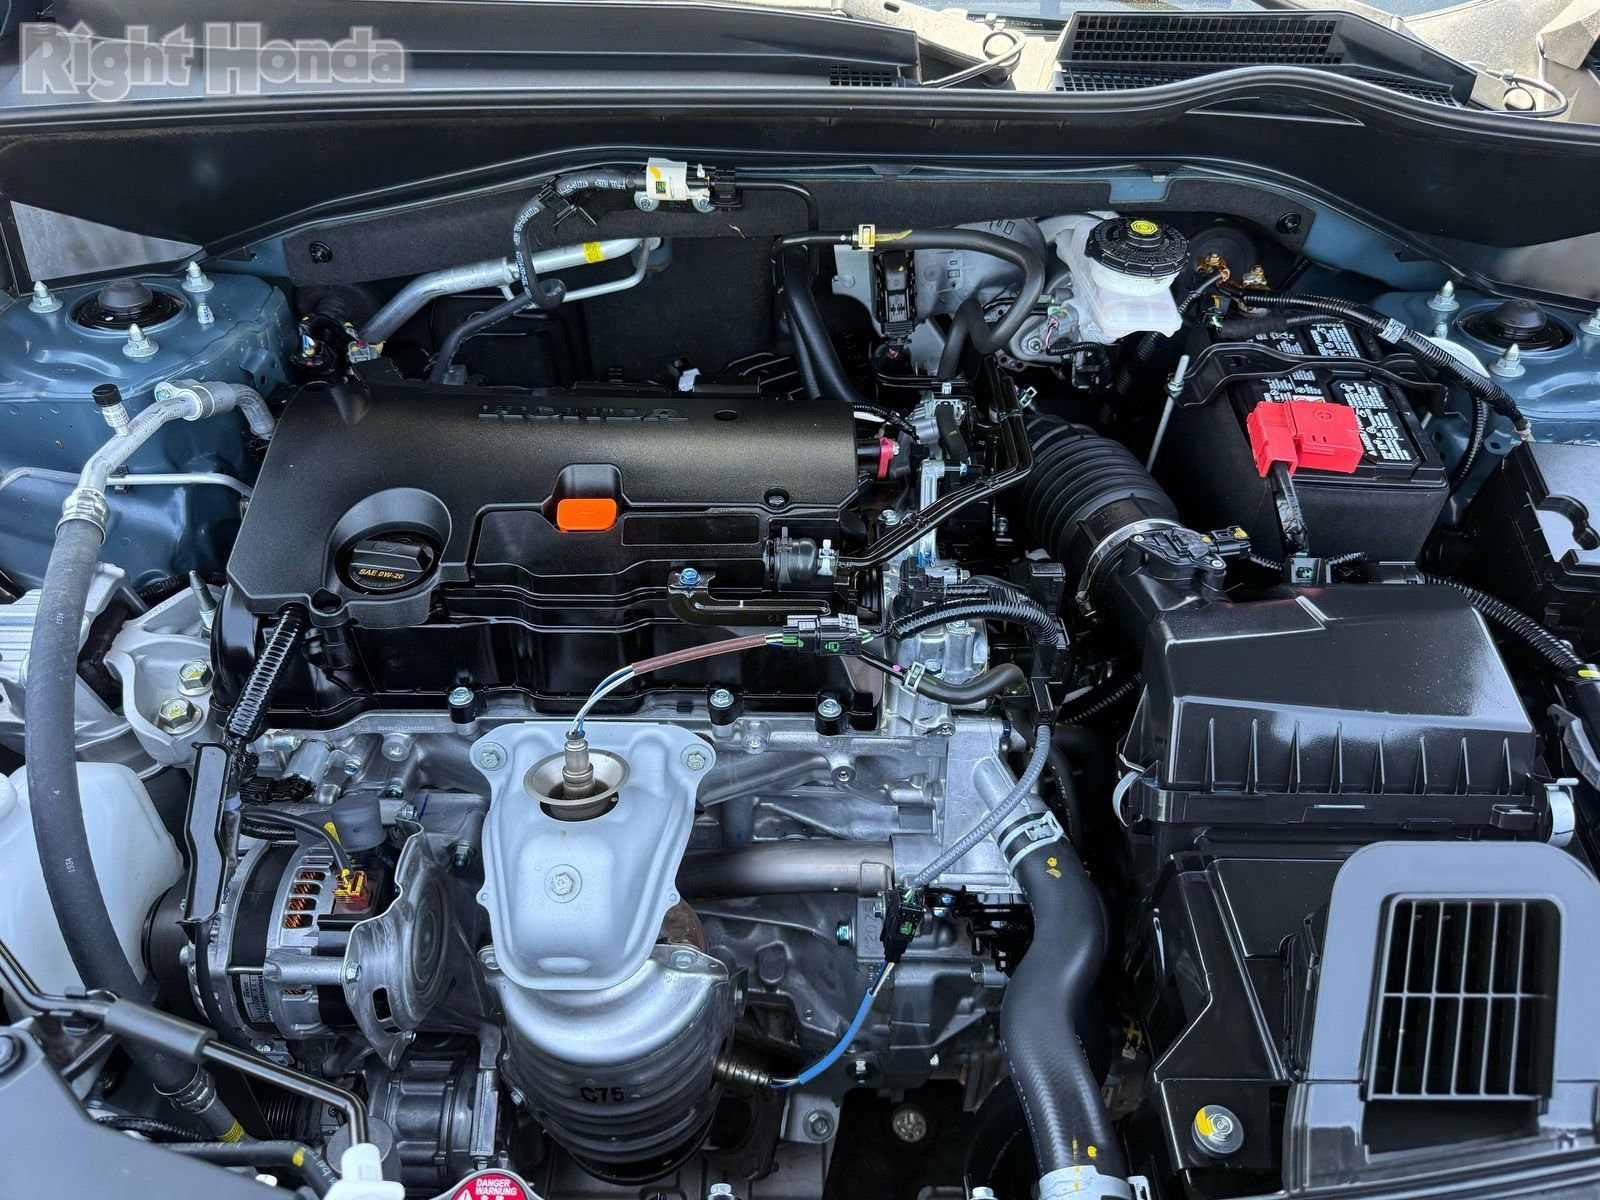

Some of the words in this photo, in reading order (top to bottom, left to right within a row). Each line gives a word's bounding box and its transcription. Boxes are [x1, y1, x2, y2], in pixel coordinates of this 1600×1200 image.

[359, 568, 378, 577] SAE
[378, 571, 405, 580] 0W-20
[580, 1086, 625, 1103] C75
[476, 1178, 511, 1187] DANGER
[475, 1186, 517, 1196] WARNUNG
